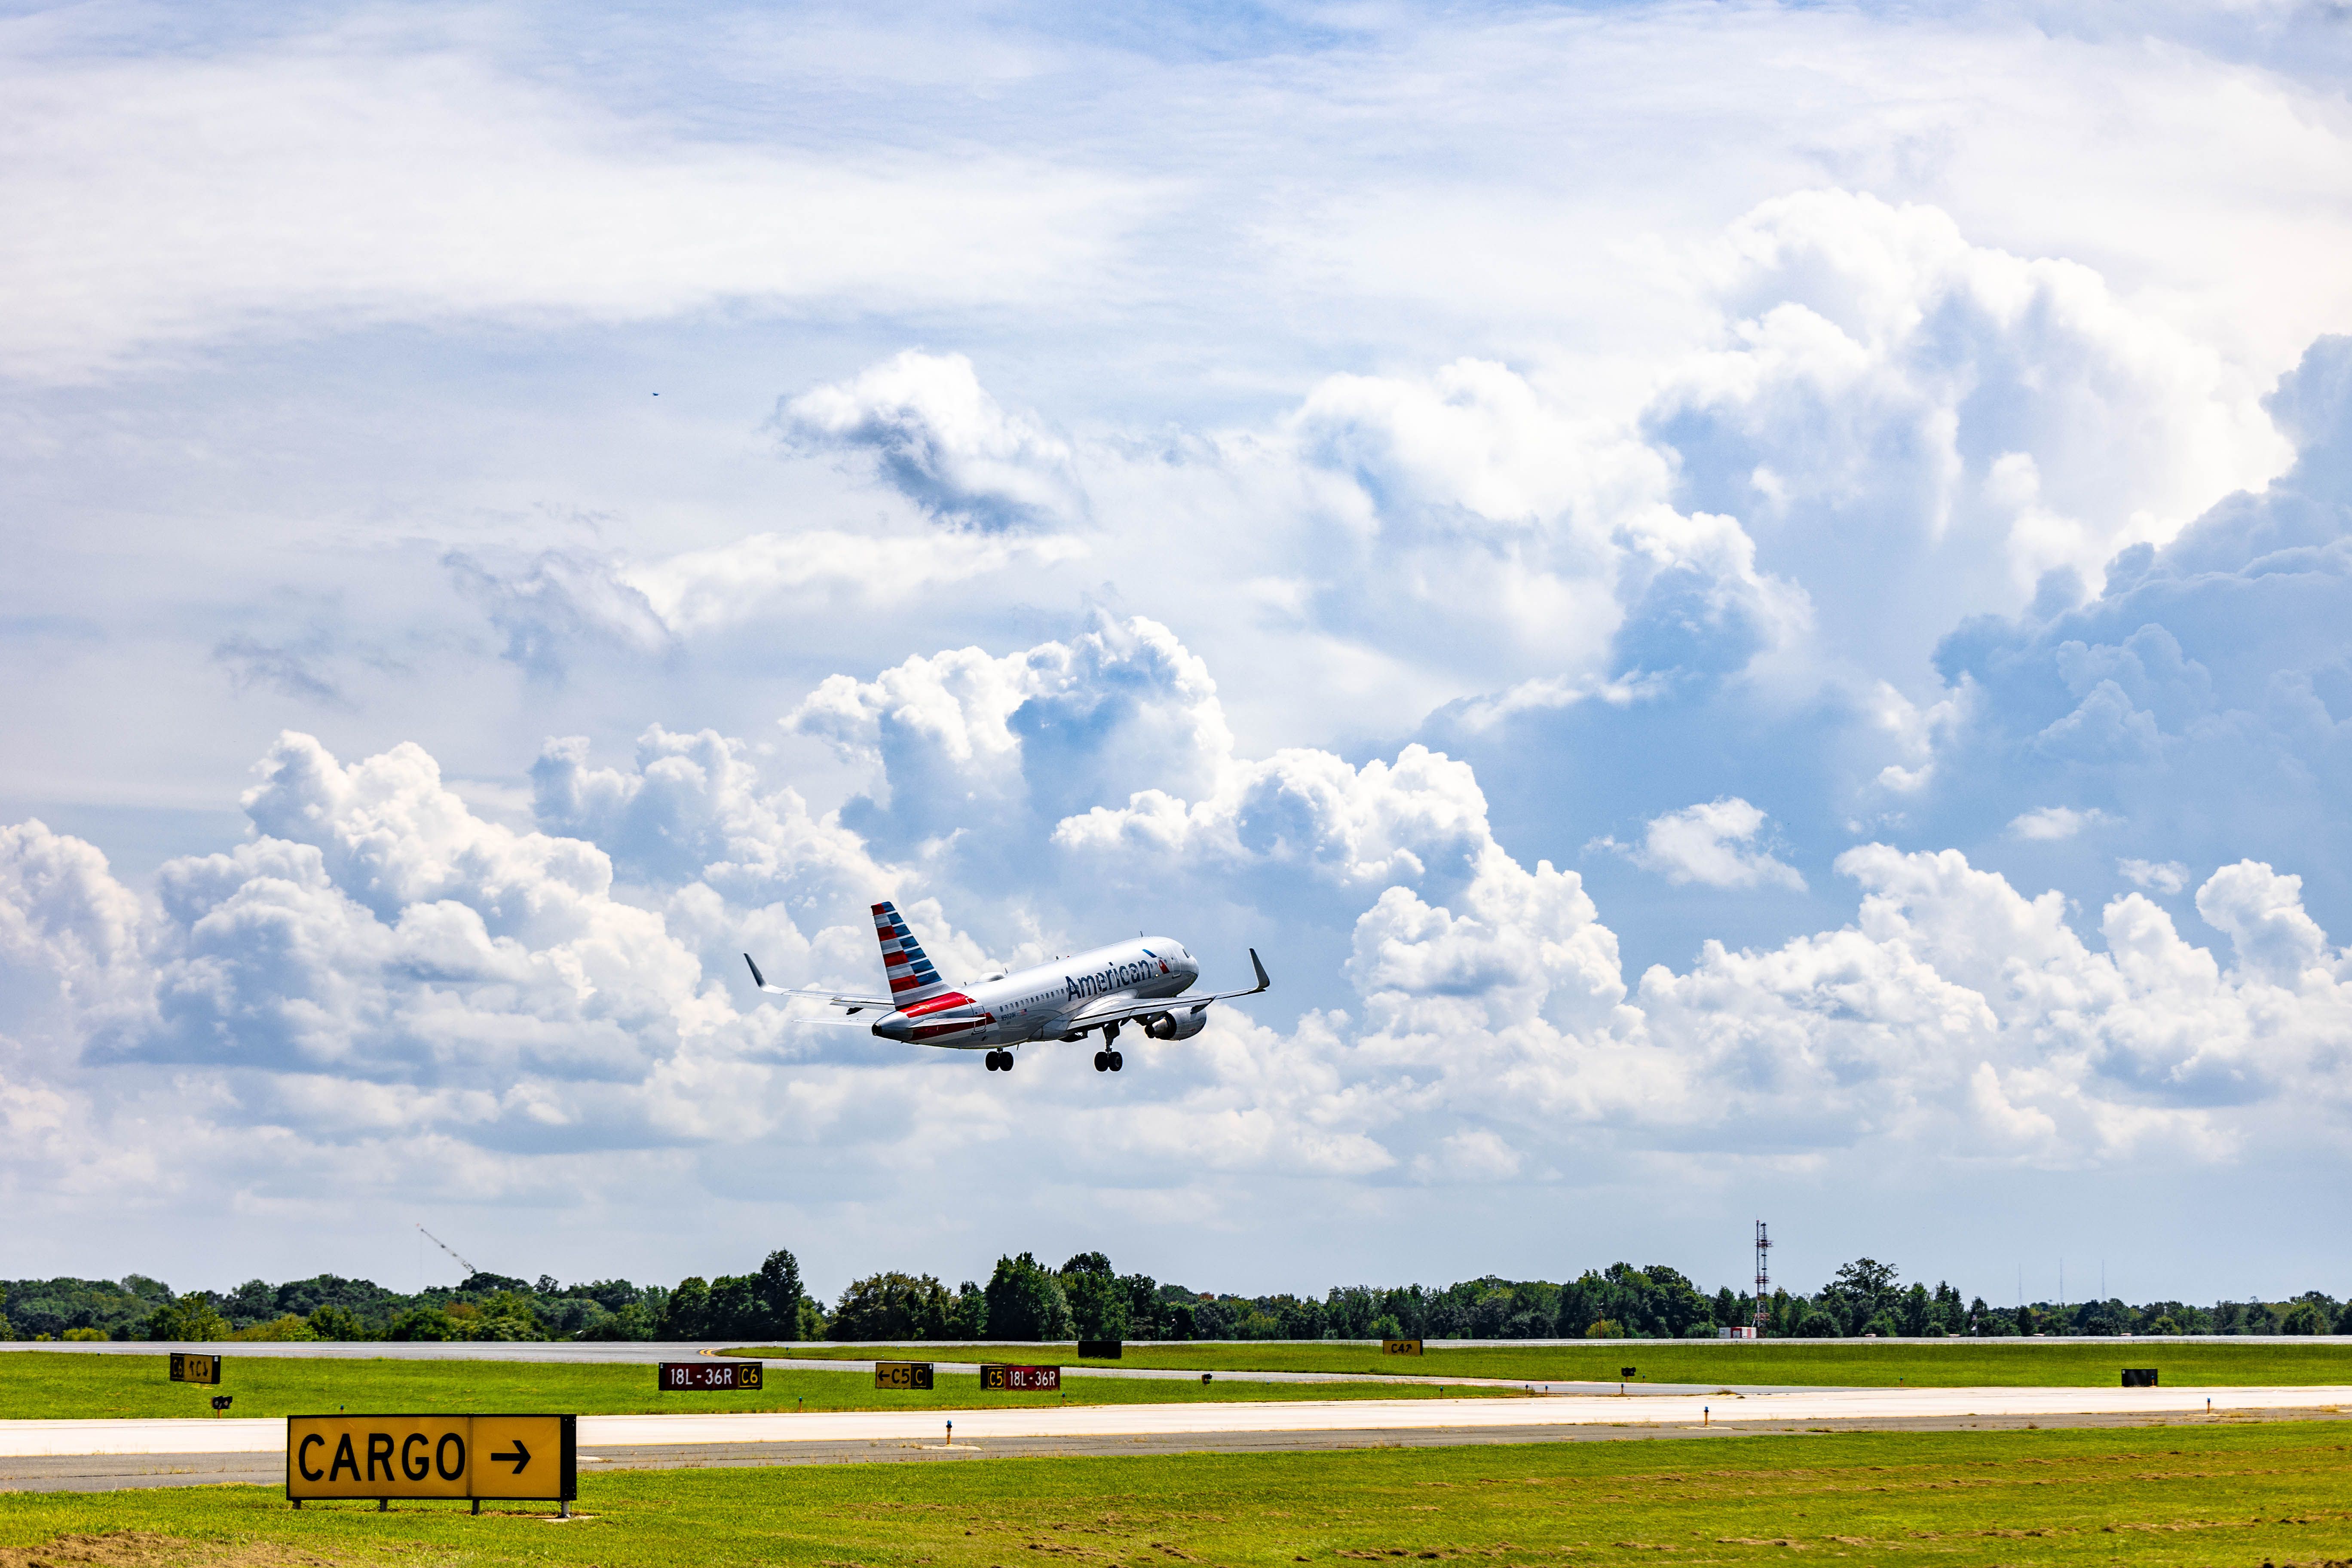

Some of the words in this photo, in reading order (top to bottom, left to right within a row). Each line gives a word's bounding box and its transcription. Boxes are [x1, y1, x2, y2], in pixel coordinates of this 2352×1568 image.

[1065, 960, 1152, 1002] American
[1391, 1343, 1404, 1354] C4
[173, 1359, 183, 1375] C6
[741, 1368, 758, 1384] C6
[891, 1368, 910, 1384] C5
[916, 1369, 923, 1384] C
[989, 1371, 1003, 1386] C5
[299, 1433, 466, 1482] CARGO
